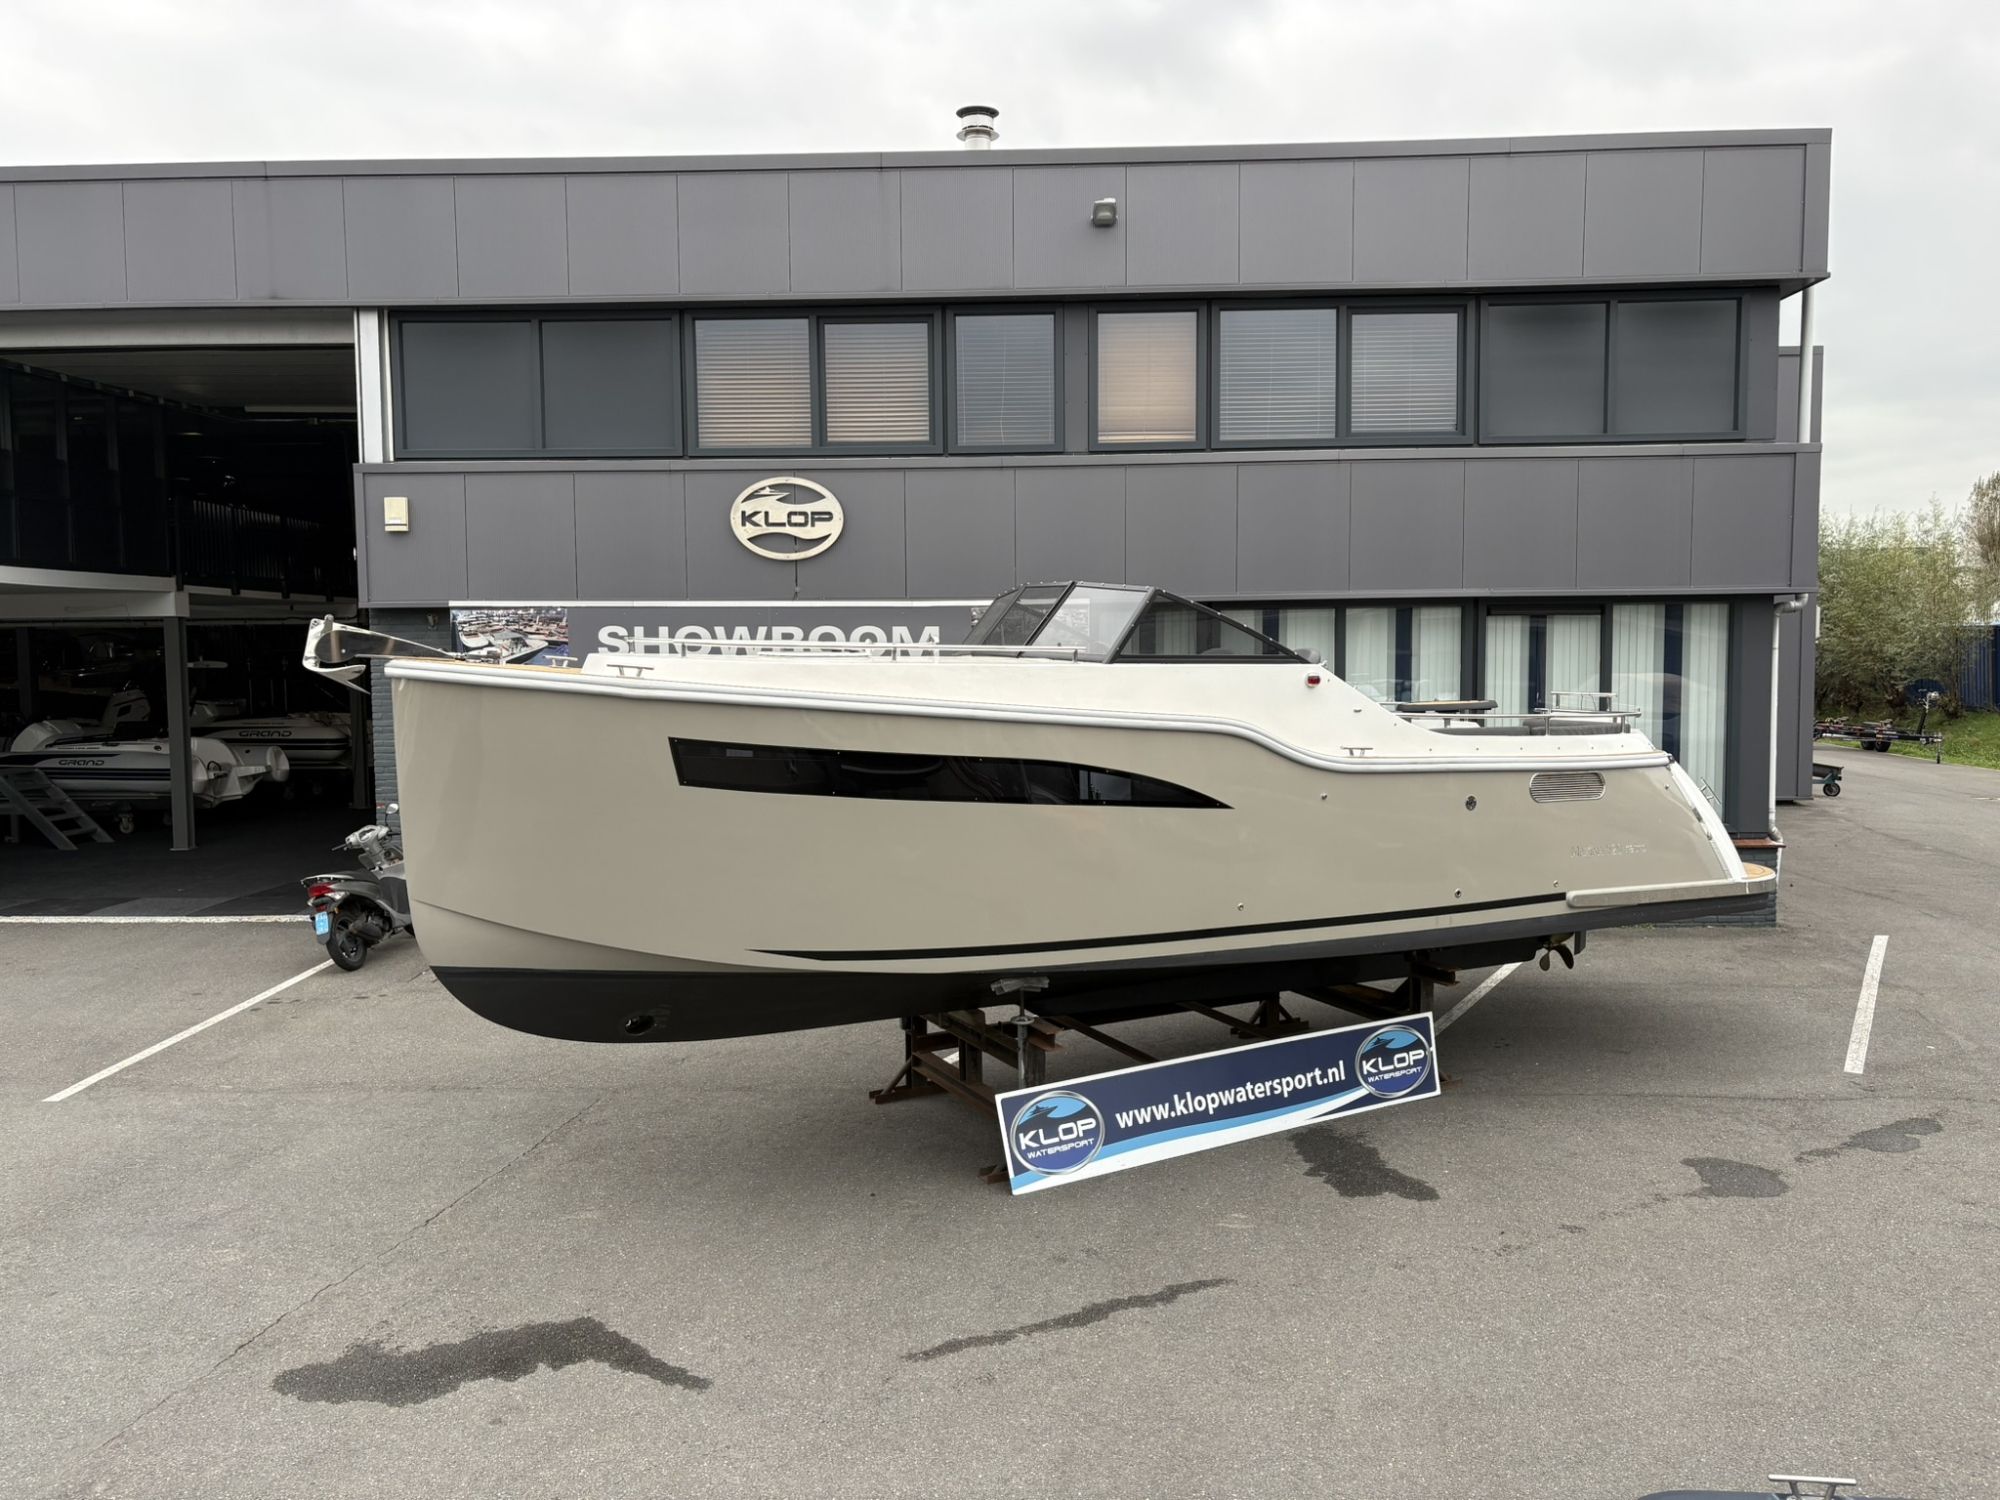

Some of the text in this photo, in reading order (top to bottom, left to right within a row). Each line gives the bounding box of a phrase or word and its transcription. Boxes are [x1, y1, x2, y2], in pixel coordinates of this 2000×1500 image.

[740, 509, 834, 528] KLOP
[598, 625, 940, 656] SHOWROOM
[238, 730, 292, 738] GRAND
[58, 759, 105, 767] GRAND
[1361, 1050, 1424, 1075] KLOP
[1367, 1066, 1422, 1082] WATERSPORT
[1116, 1060, 1346, 1128] www.klopwatersport.nl
[1019, 1118, 1096, 1150] KLOP
[1027, 1138, 1094, 1159] WATERSPORT
